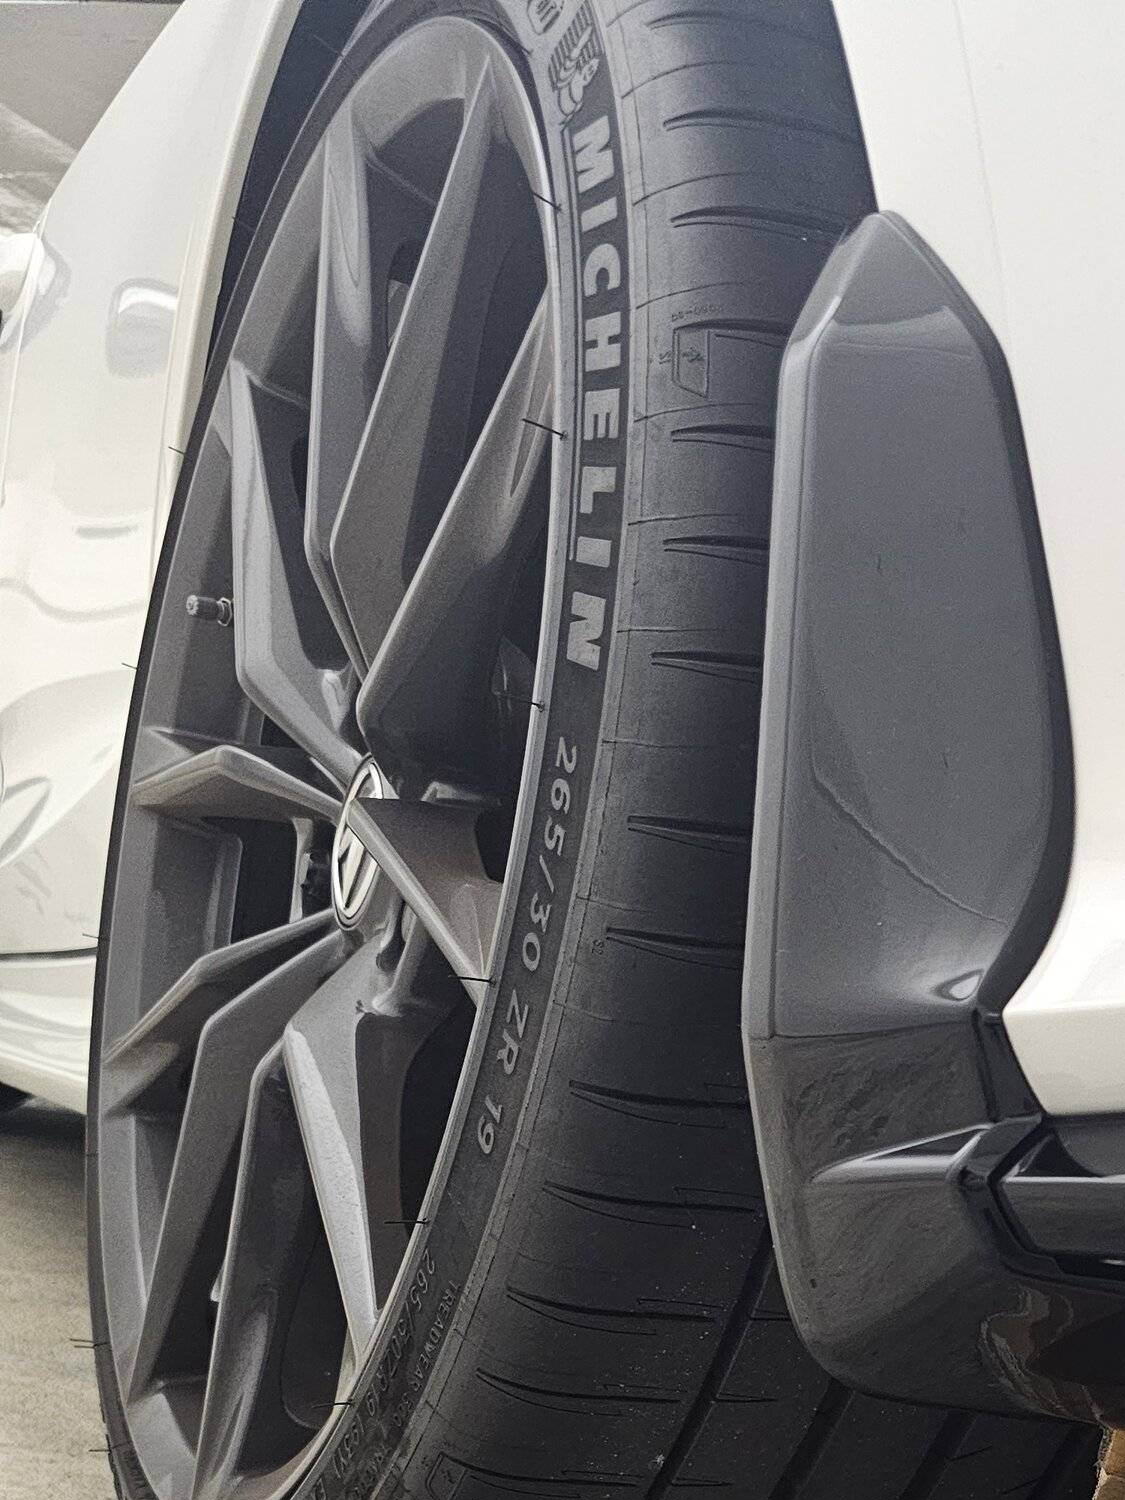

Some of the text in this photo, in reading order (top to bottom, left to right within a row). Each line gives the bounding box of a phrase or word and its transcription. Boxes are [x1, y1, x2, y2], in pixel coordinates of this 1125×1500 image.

[566, 115, 621, 671] MICHELIN
[477, 736, 577, 1155] 265/30 ZR 19
